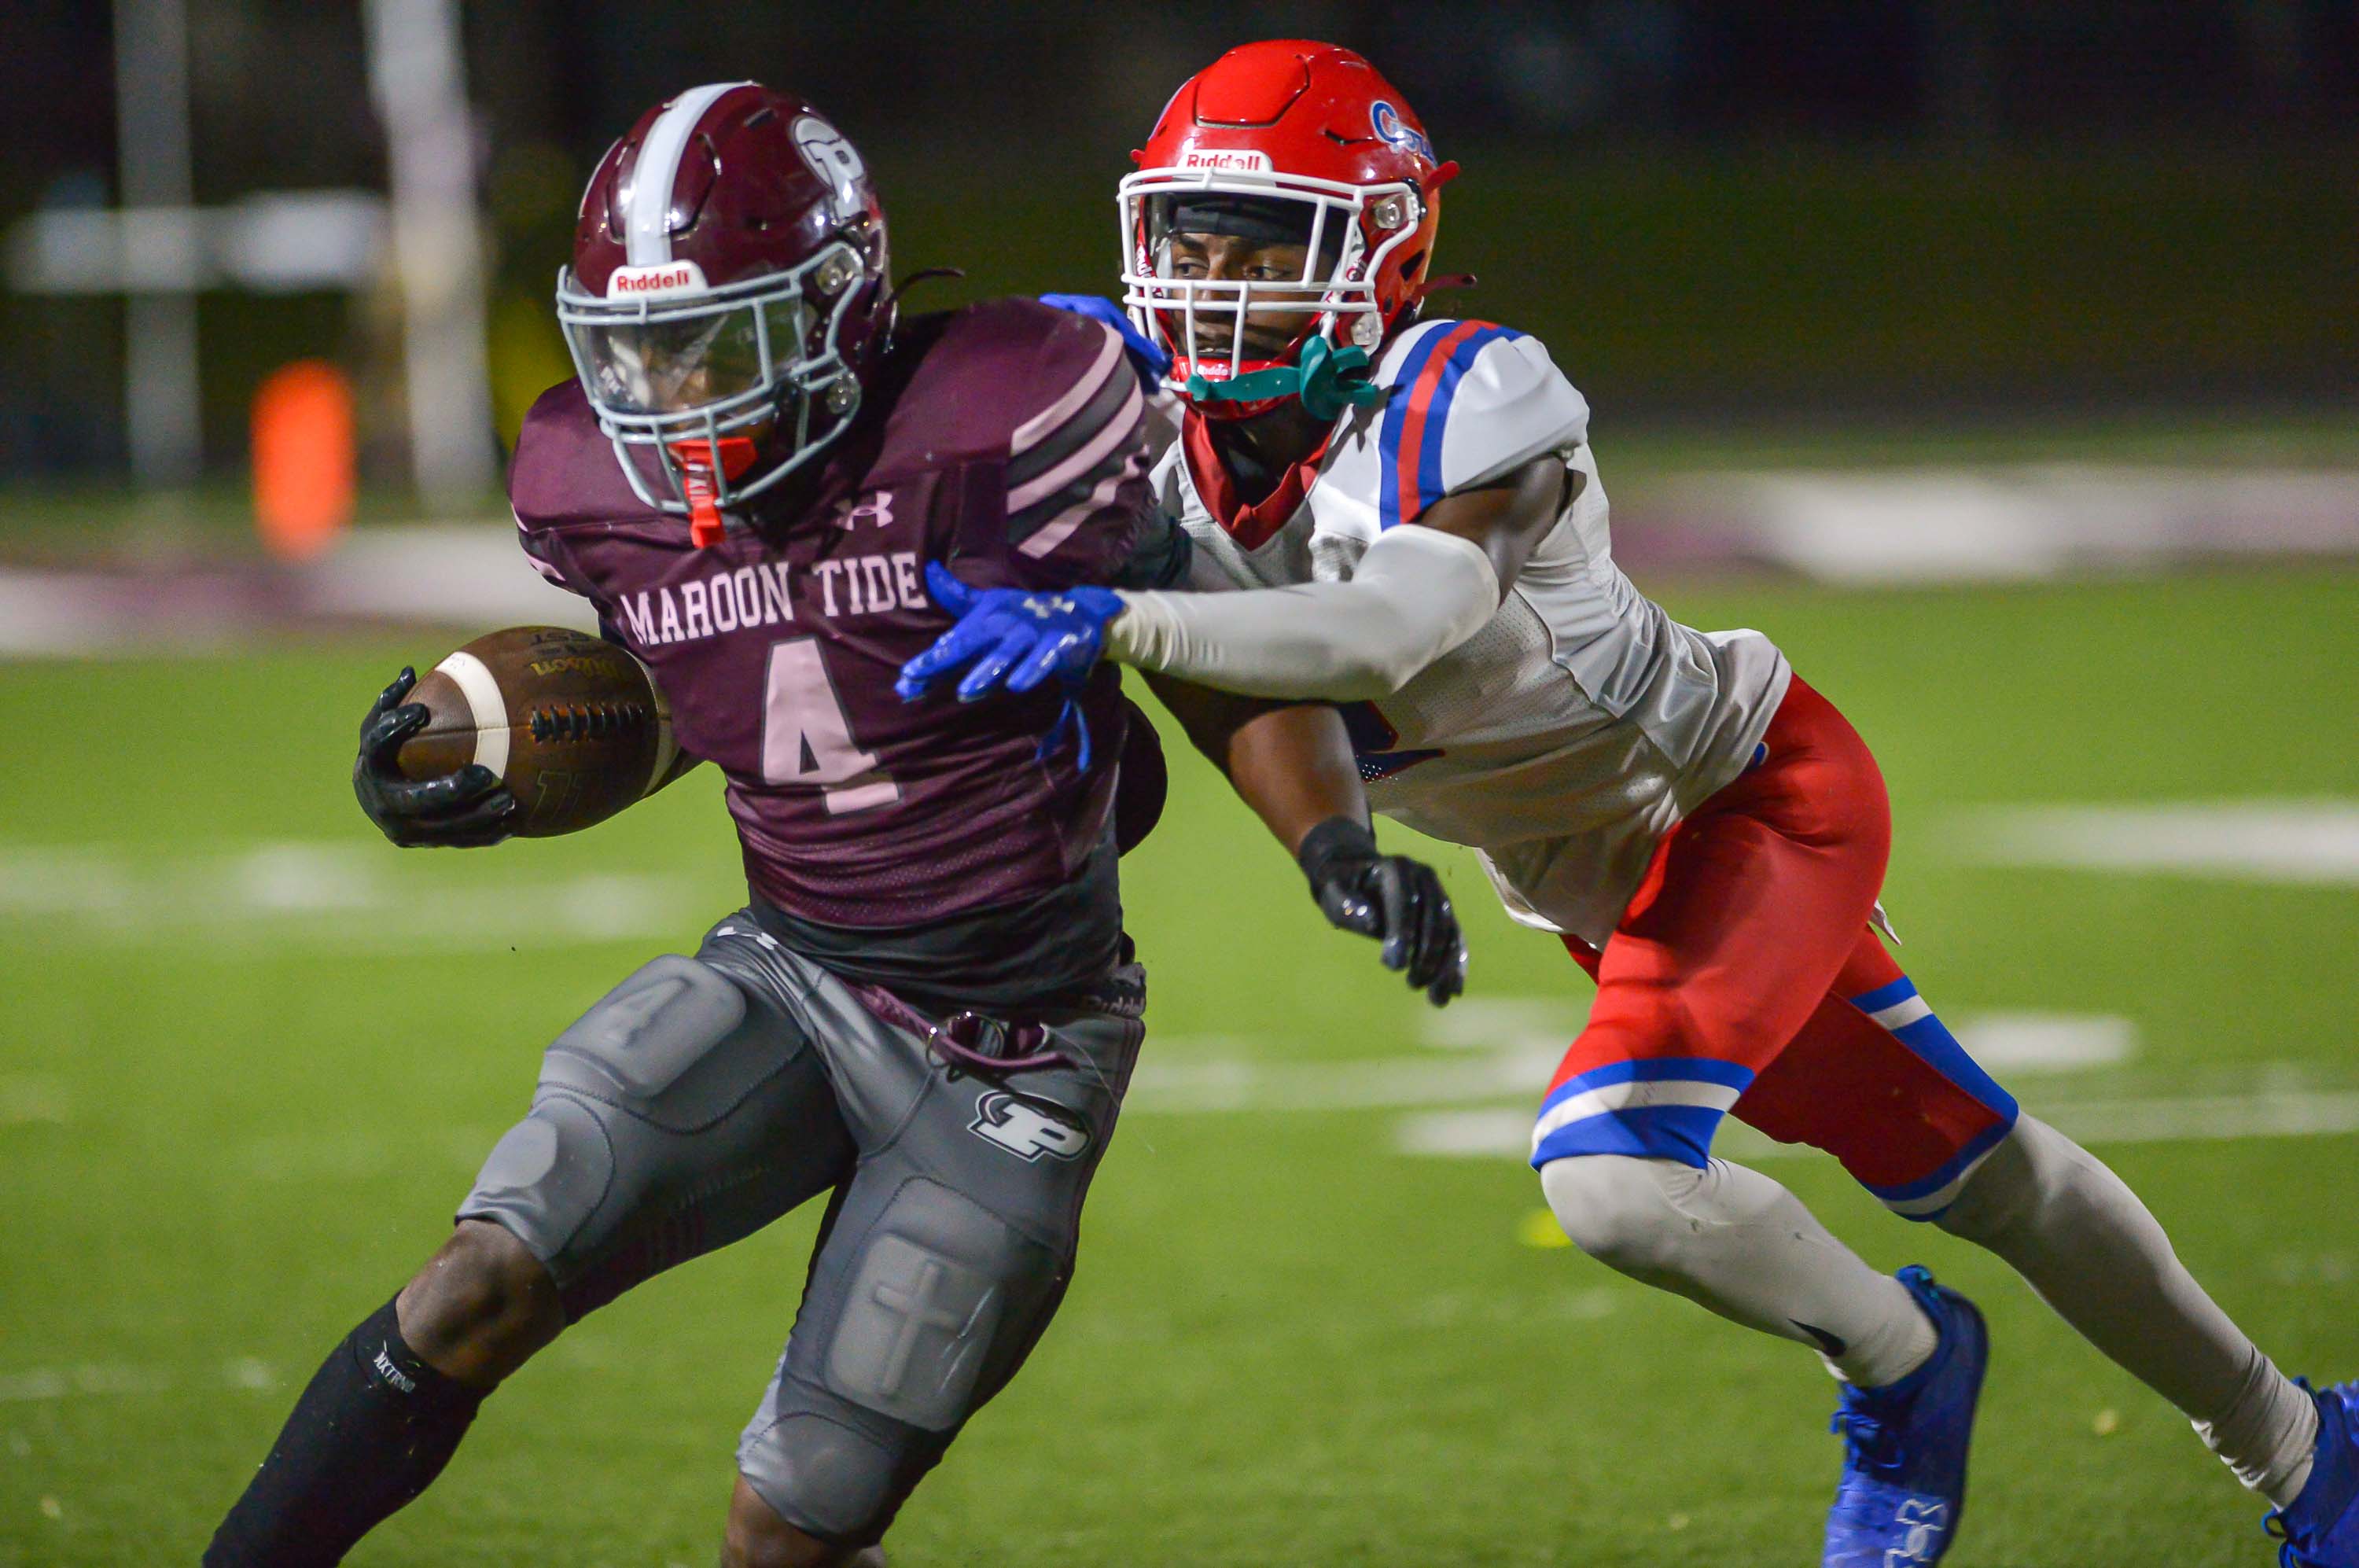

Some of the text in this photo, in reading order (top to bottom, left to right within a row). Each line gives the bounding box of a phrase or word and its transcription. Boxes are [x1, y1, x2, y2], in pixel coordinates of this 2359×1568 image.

[616, 270, 690, 291] Riddell
[620, 552, 929, 646] MAROON TIDE
[761, 635, 902, 816] 4
